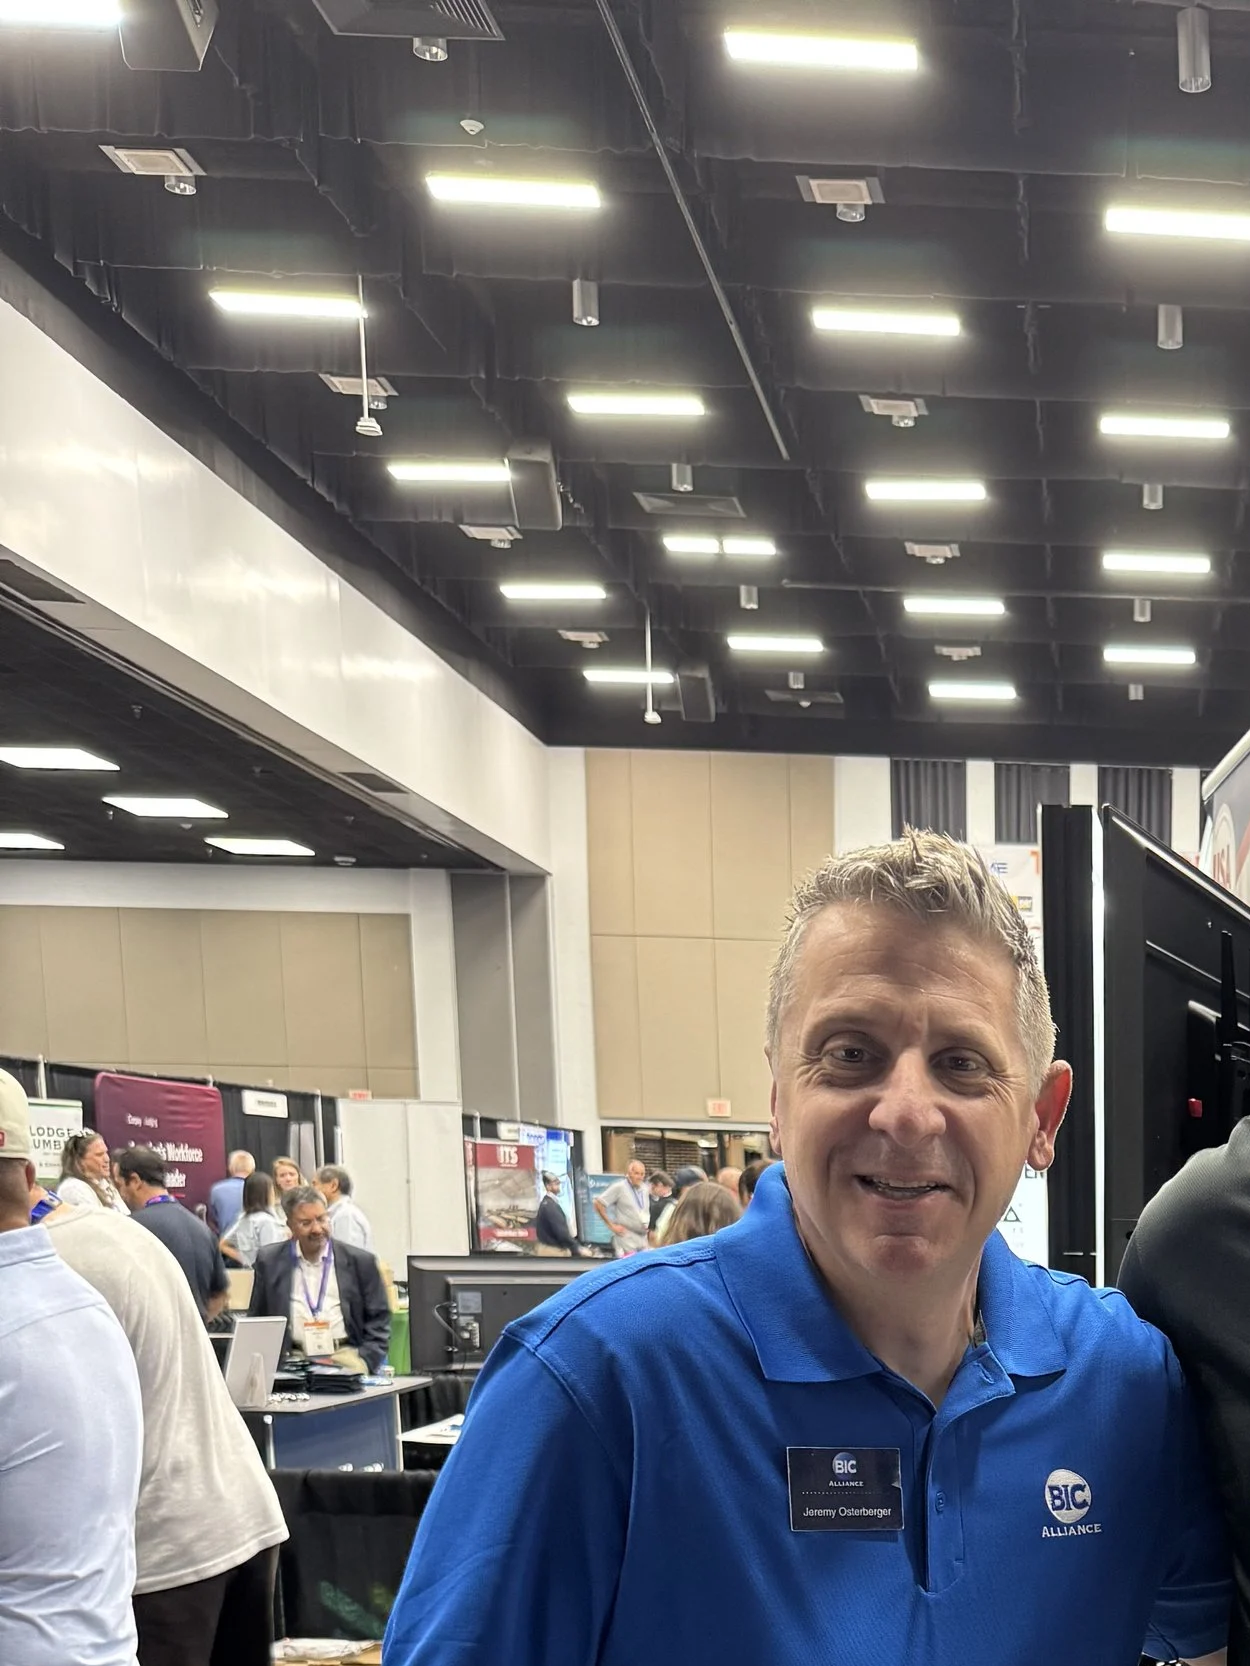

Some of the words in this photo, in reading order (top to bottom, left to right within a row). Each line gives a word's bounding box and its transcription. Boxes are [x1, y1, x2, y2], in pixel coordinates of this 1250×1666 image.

[33, 1139, 66, 1150] UMB
[166, 1141, 203, 1162] Workforce
[164, 1168, 186, 1187] eader
[834, 1459, 857, 1474] BIC
[1047, 1483, 1090, 1511] BIC
[803, 1507, 836, 1518] Jeremy
[839, 1506, 891, 1519] Osterberger
[1042, 1523, 1102, 1538] ALLIANCE
